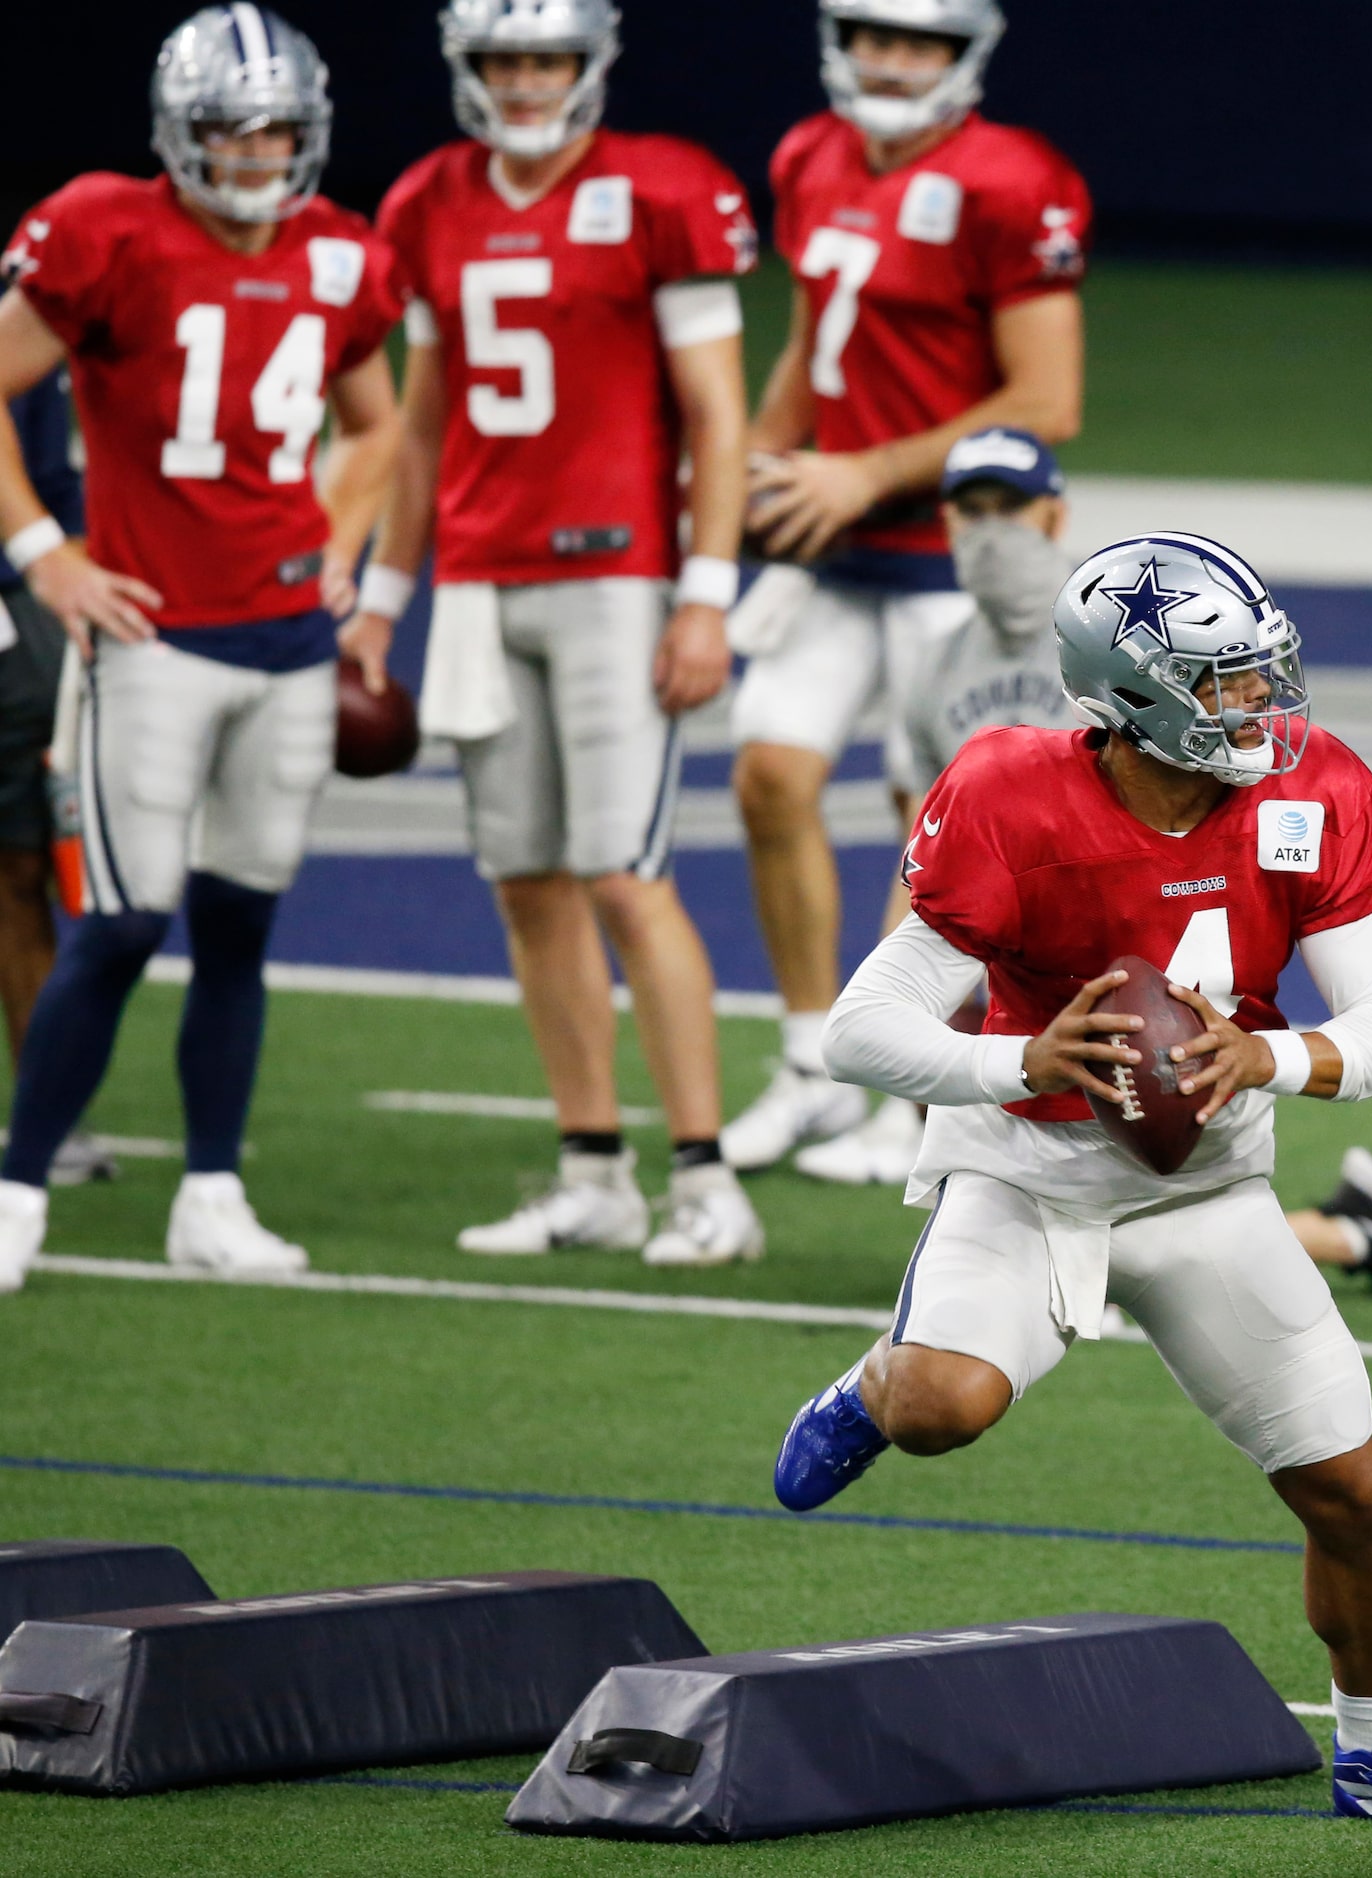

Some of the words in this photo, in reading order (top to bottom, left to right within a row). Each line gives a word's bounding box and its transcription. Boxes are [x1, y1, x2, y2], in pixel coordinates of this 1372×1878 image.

[461, 257, 555, 437] 5
[800, 226, 880, 398] 7
[161, 303, 327, 484] 14
[1161, 875, 1227, 898] COWBOYS
[1273, 847, 1311, 863] AT&T
[1163, 907, 1246, 1020] 4
